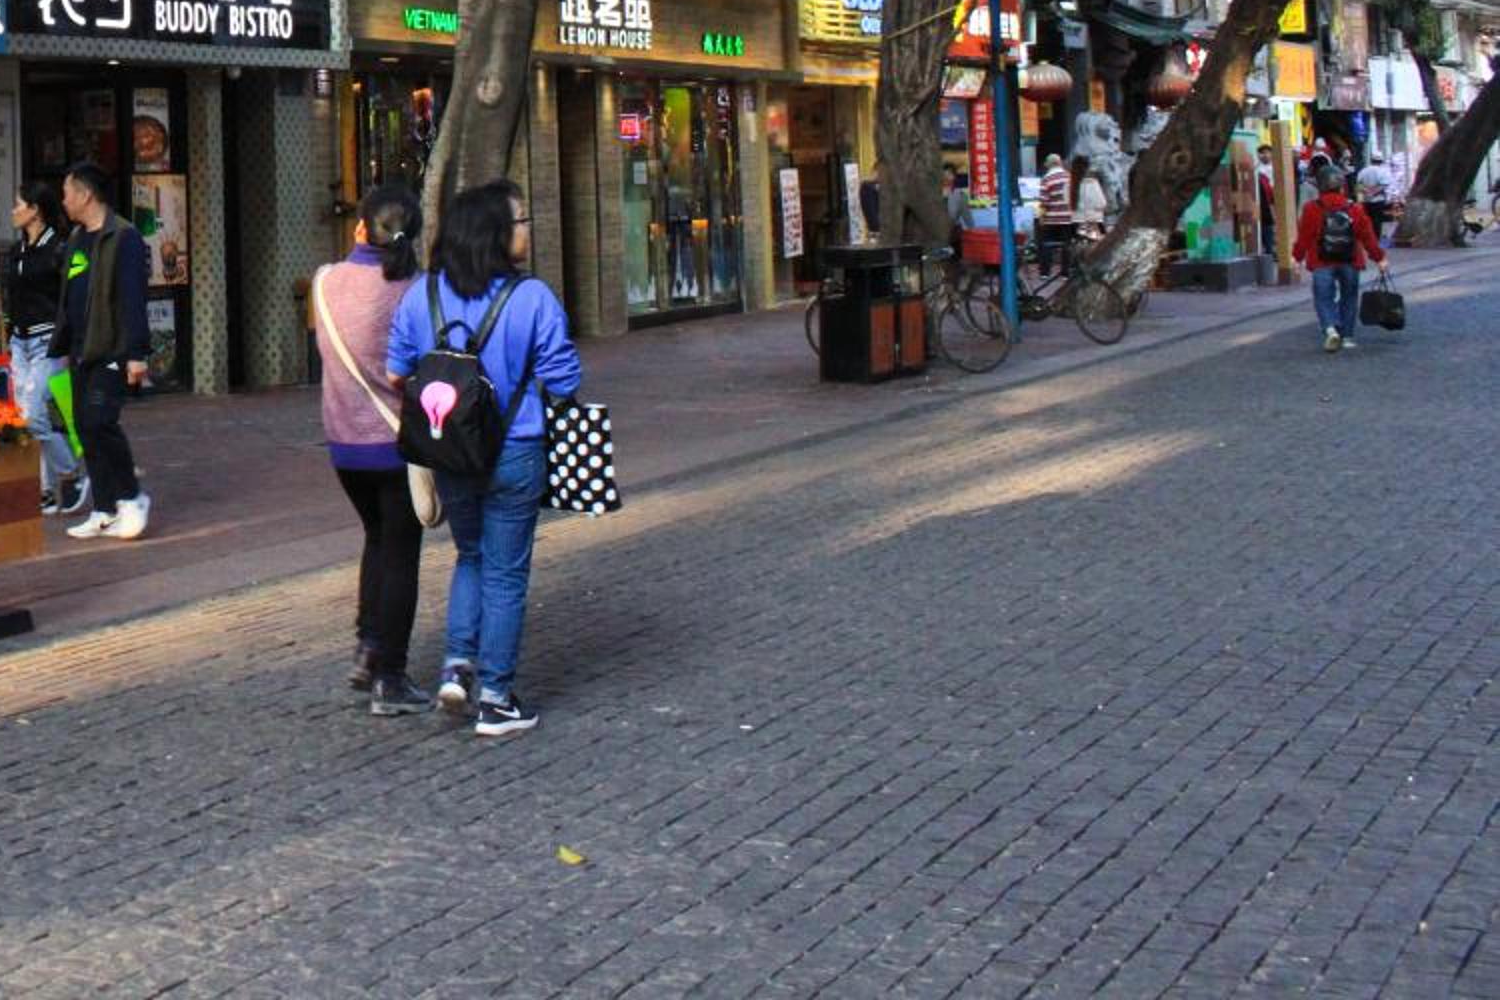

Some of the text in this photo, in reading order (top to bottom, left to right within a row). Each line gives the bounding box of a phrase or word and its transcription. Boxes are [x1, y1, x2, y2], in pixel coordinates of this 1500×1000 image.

[155, 0, 293, 40] BUDDY BISTRO
[560, 26, 652, 50] LEMON HOUSE
